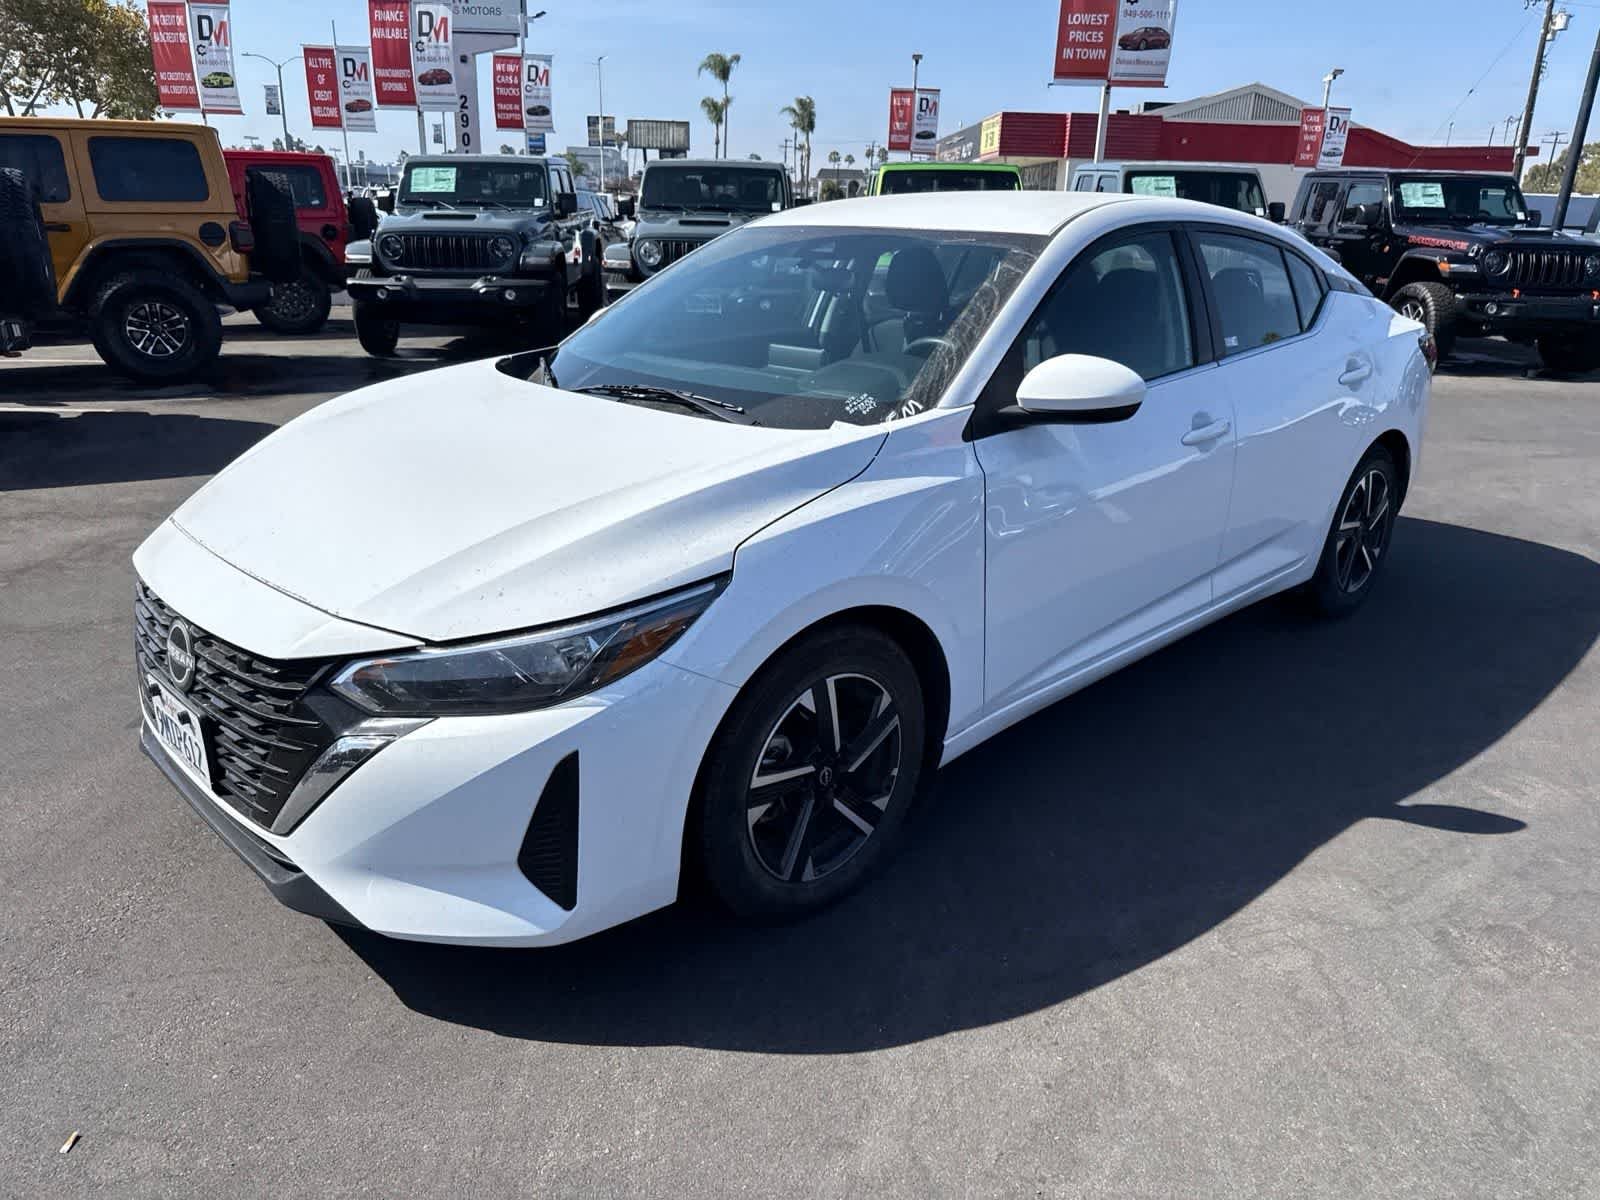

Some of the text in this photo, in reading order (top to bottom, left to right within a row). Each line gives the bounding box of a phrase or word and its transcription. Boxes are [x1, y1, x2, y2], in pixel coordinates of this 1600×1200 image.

[374, 10, 404, 22] FINANCE
[462, 6, 502, 16] MOTORS
[1068, 13, 1110, 26] LOWEST
[372, 27, 408, 40] AVAILABLE
[1069, 30, 1104, 43] PRICES
[1063, 48, 1106, 60] IN TOWN
[308, 57, 331, 69] ALL TYPE
[496, 64, 519, 72] WE BUY
[317, 74, 325, 85] OF
[496, 75, 513, 84] CARS
[314, 90, 332, 101] CREDIT
[496, 87, 520, 96] TRUCKS
[312, 106, 338, 117] WELCOME
[460, 94, 471, 153] 290
